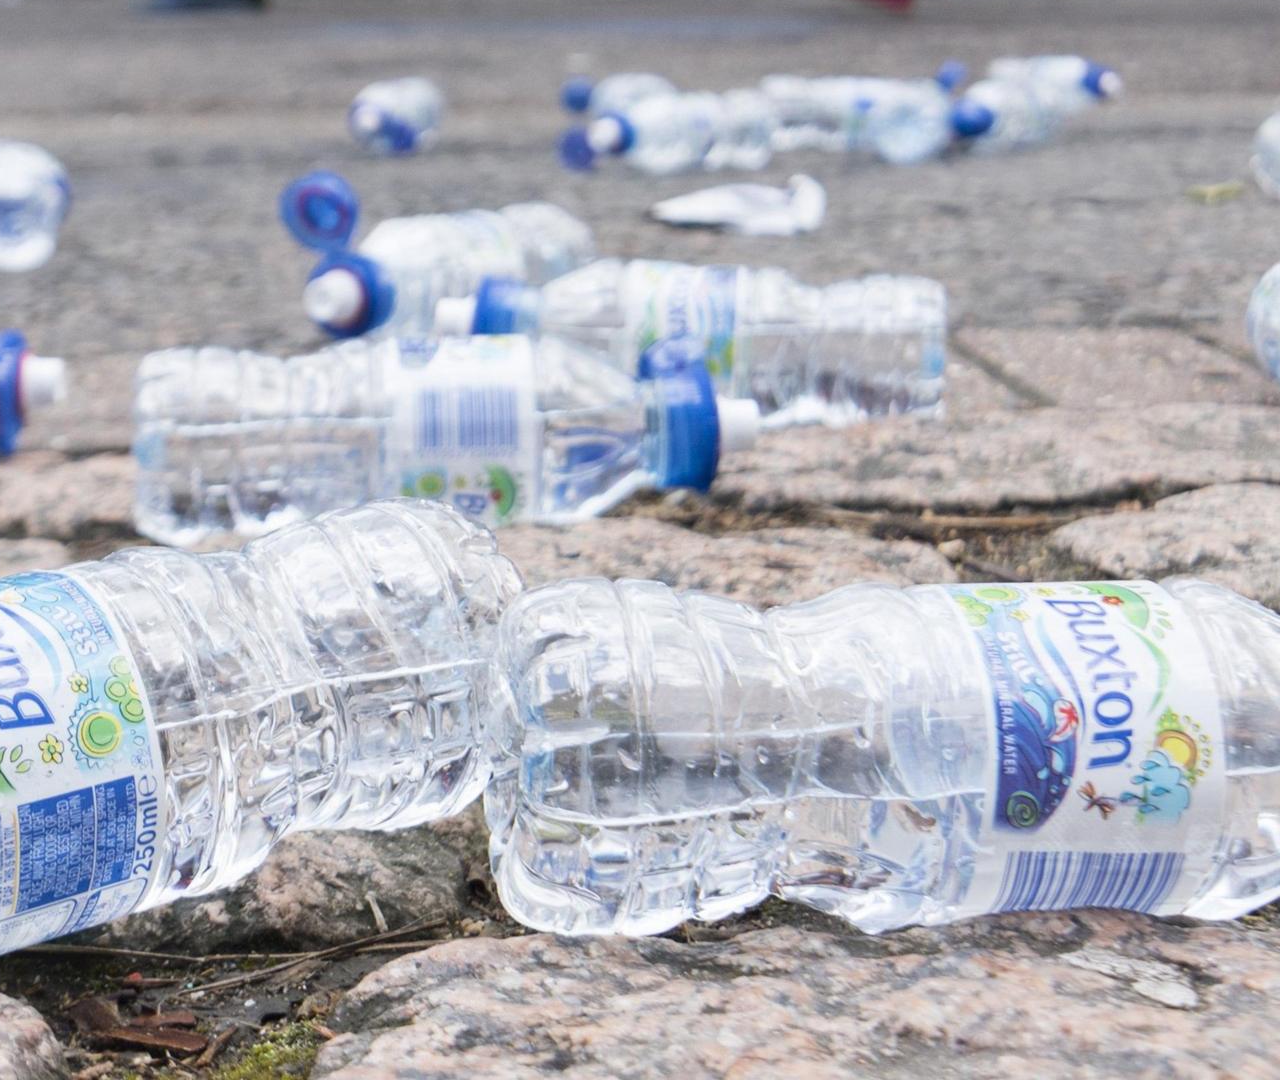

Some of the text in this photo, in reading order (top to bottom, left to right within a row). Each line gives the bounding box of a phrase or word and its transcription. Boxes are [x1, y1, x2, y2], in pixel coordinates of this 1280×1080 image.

[1044, 598, 1137, 770] Buxton
[982, 632, 1017, 775] NATURAL MINERAL WATER
[57, 800, 68, 831] SERVED
[106, 798, 115, 836] SOURCE
[126, 814, 134, 848] WATERS
[69, 824, 81, 864] CONSUME
[115, 823, 125, 862] ENGLAND
[103, 847, 114, 881] BOTTLED
